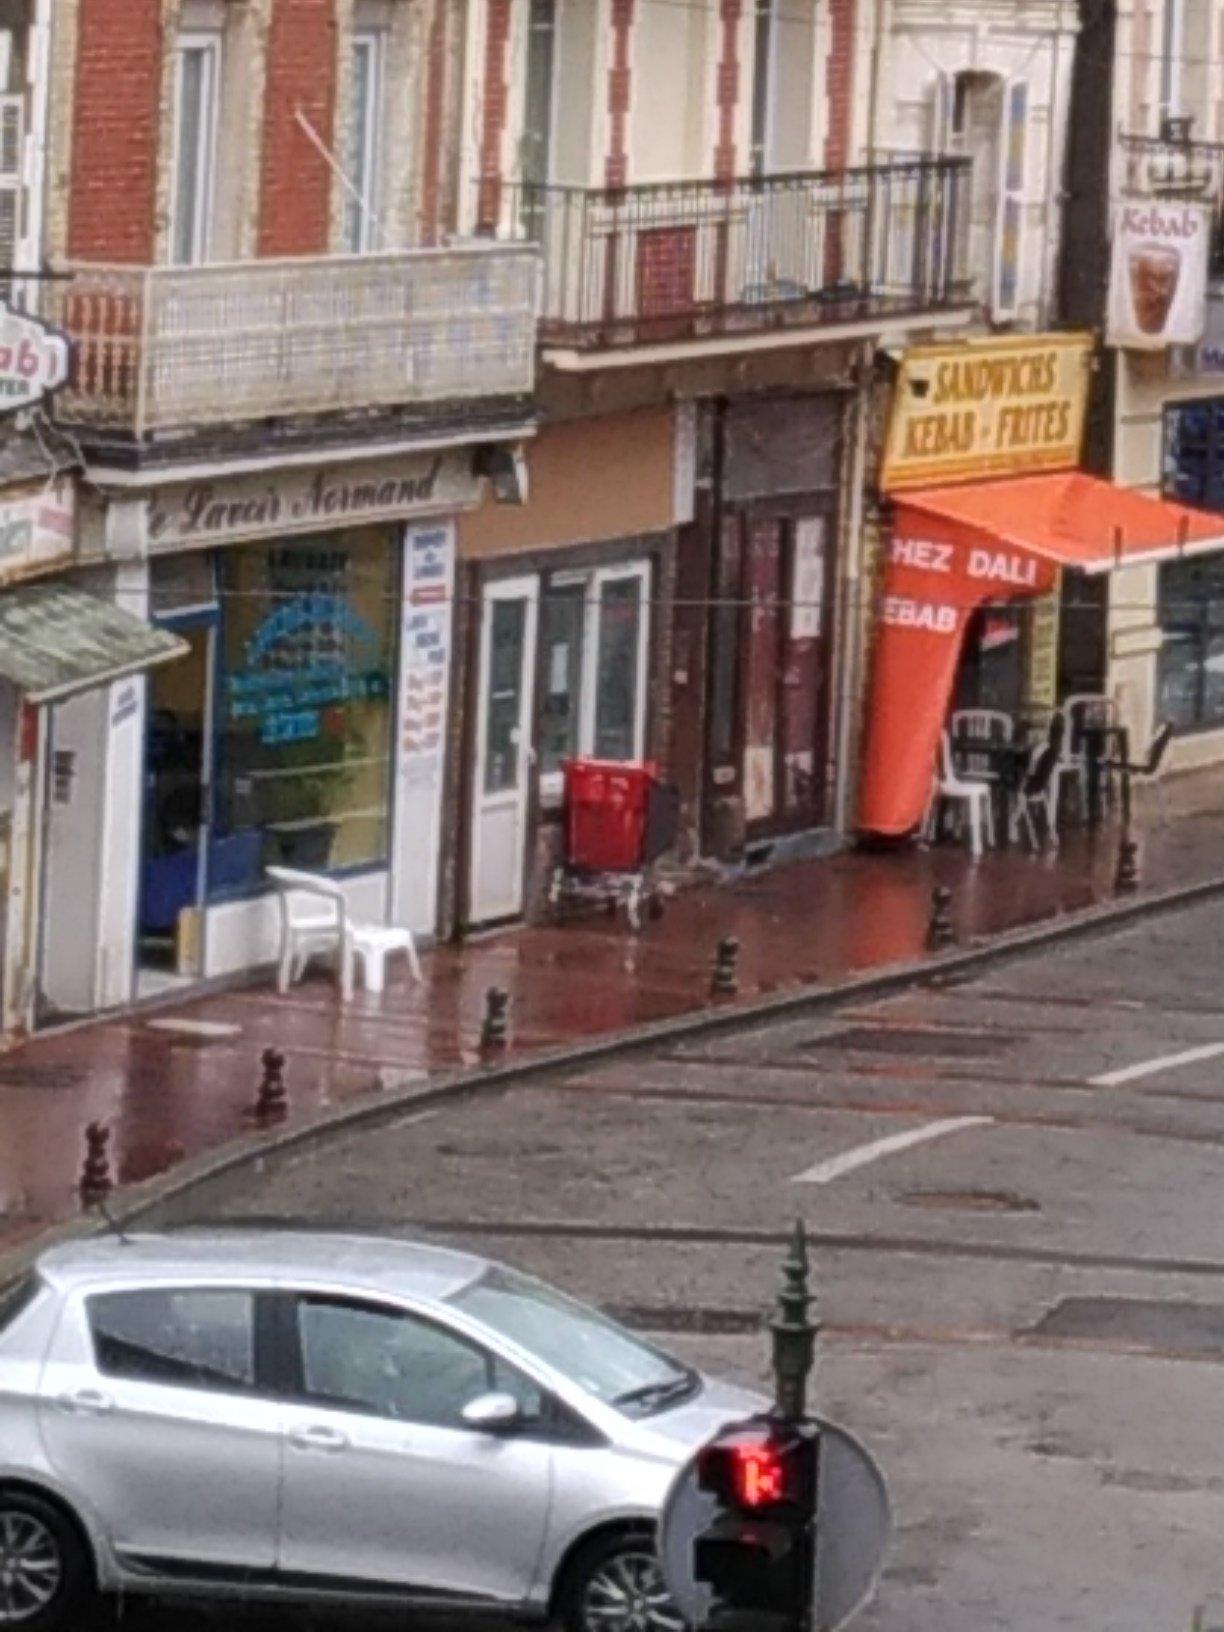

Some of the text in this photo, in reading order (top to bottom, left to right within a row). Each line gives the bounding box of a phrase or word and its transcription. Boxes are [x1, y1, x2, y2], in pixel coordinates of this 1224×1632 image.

[1121, 207, 1198, 238] Kebab
[903, 411, 976, 459] KEBAB
[996, 400, 1072, 449] FRITES
[892, 538, 1037, 586] HEZ DALI
[883, 597, 957, 634] EBAB
